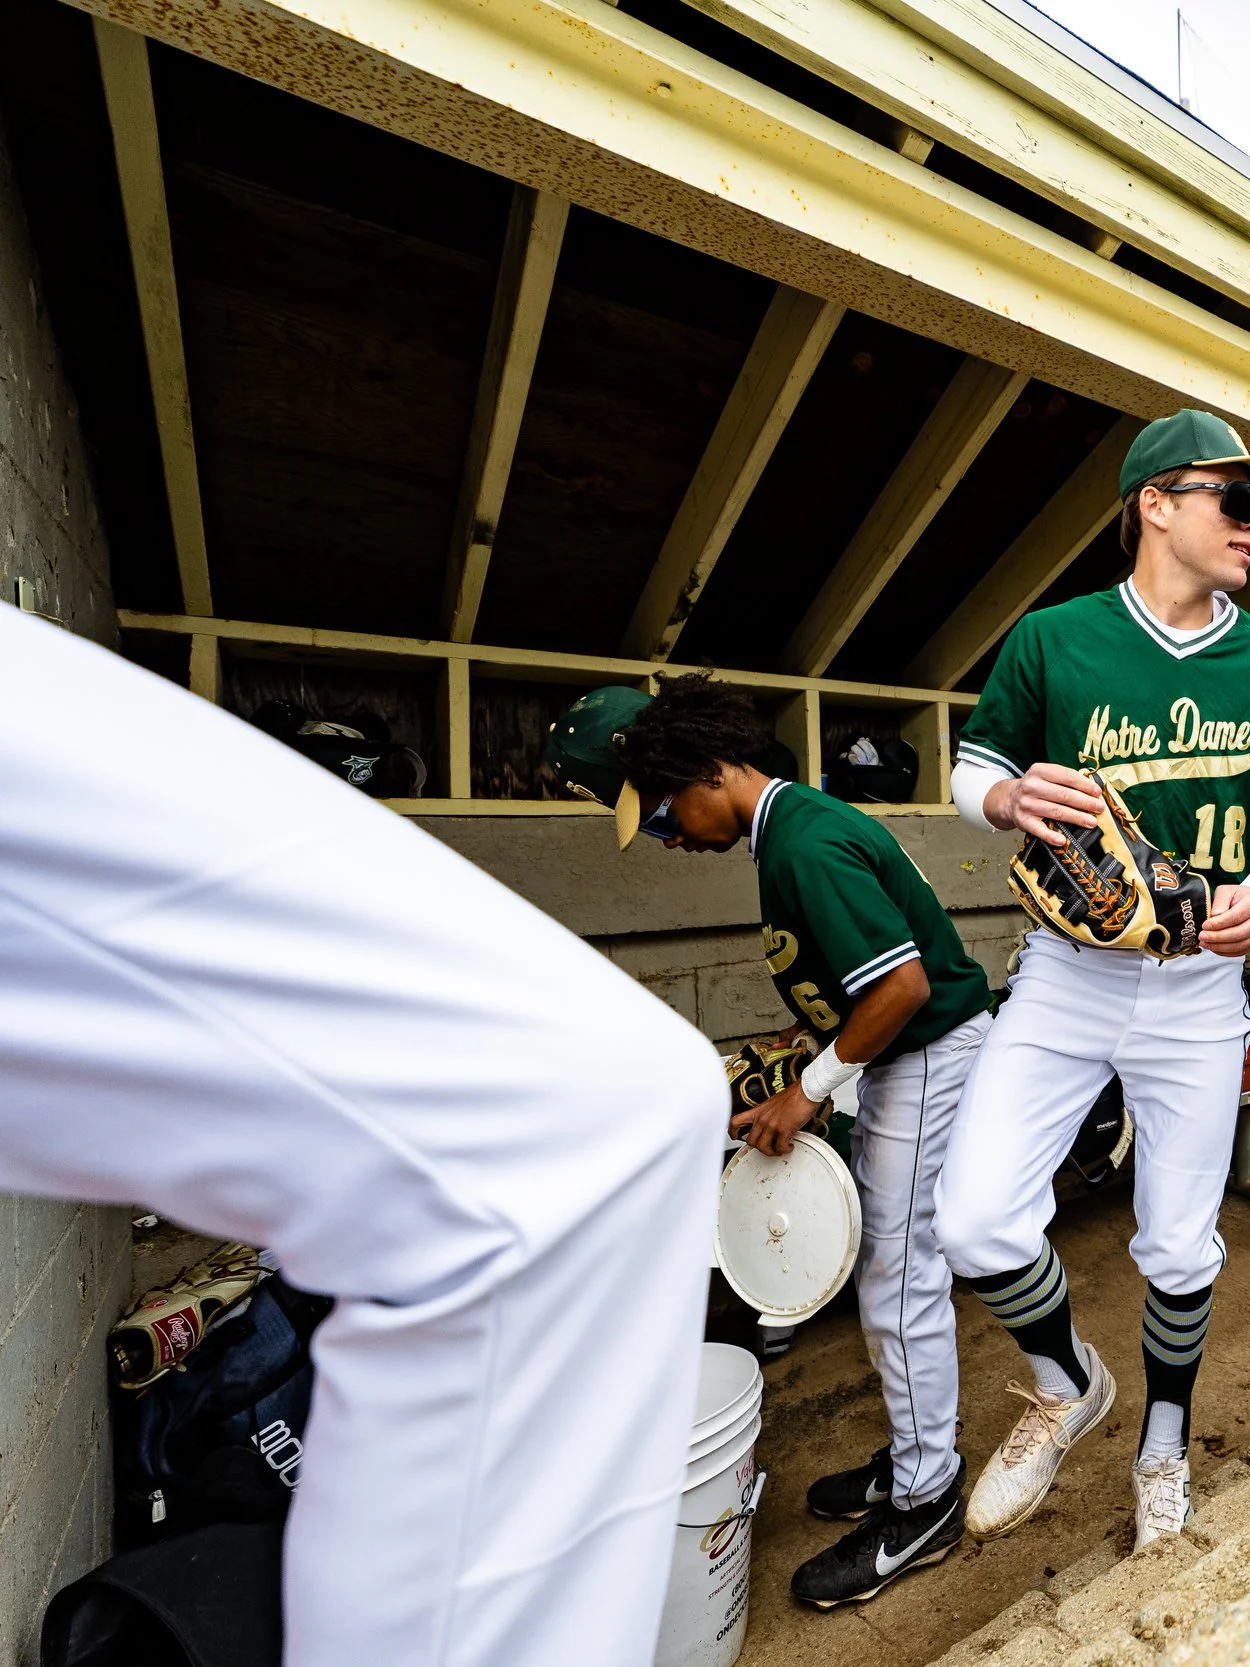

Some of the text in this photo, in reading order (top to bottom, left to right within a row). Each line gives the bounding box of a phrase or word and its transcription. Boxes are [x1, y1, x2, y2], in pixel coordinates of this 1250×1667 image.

[1078, 703, 1161, 764] Notre
[1189, 803, 1247, 873] 18
[708, 1544, 740, 1577] BASEBALL
